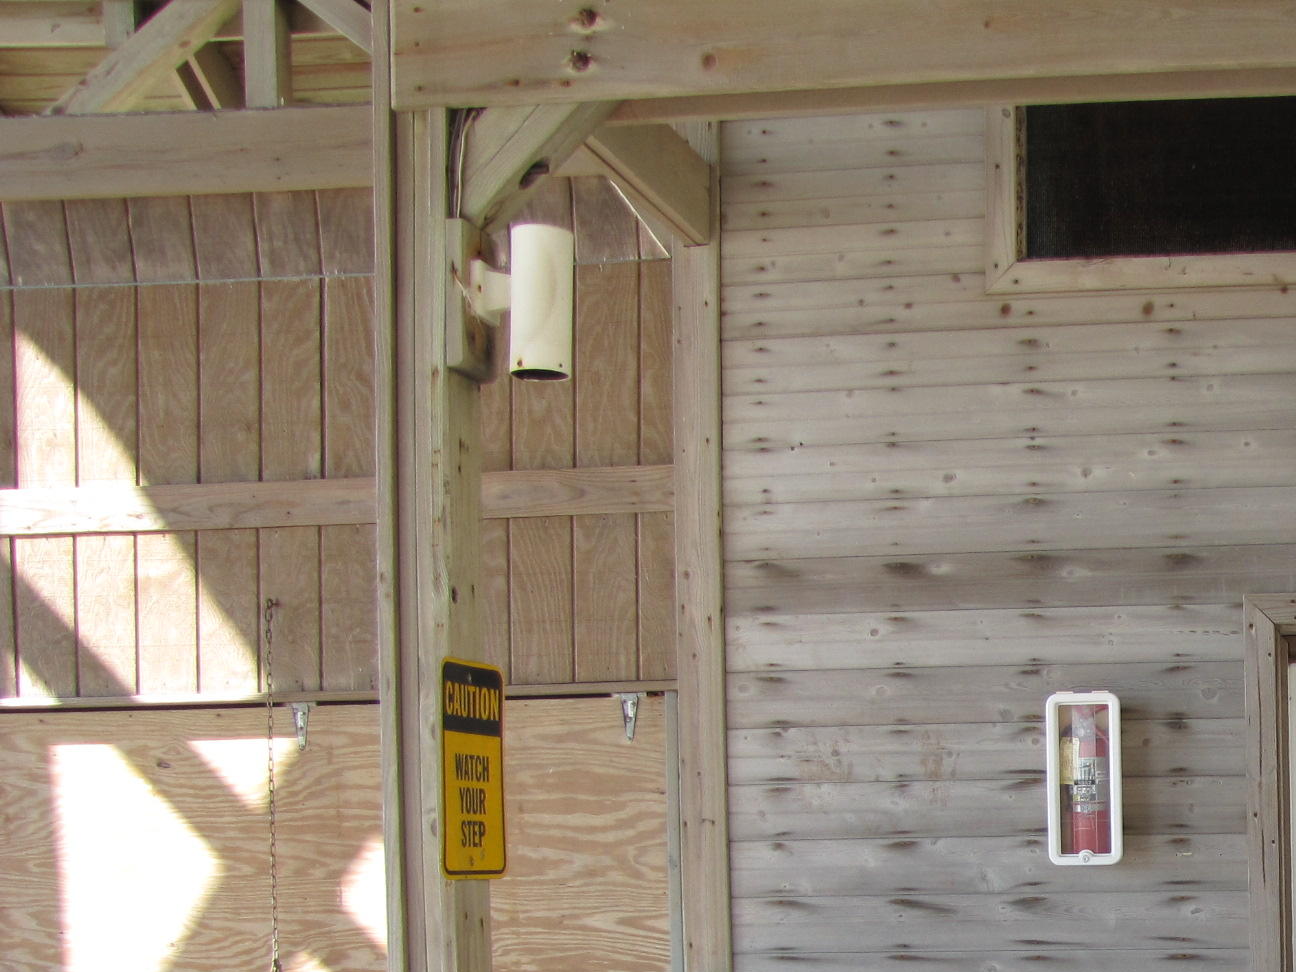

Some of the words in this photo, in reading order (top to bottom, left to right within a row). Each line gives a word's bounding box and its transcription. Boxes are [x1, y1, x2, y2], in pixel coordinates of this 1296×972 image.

[445, 681, 500, 721] CAUTION
[455, 752, 490, 782] WATCH
[459, 786, 486, 815] YOUR
[461, 820, 486, 848] STEP
